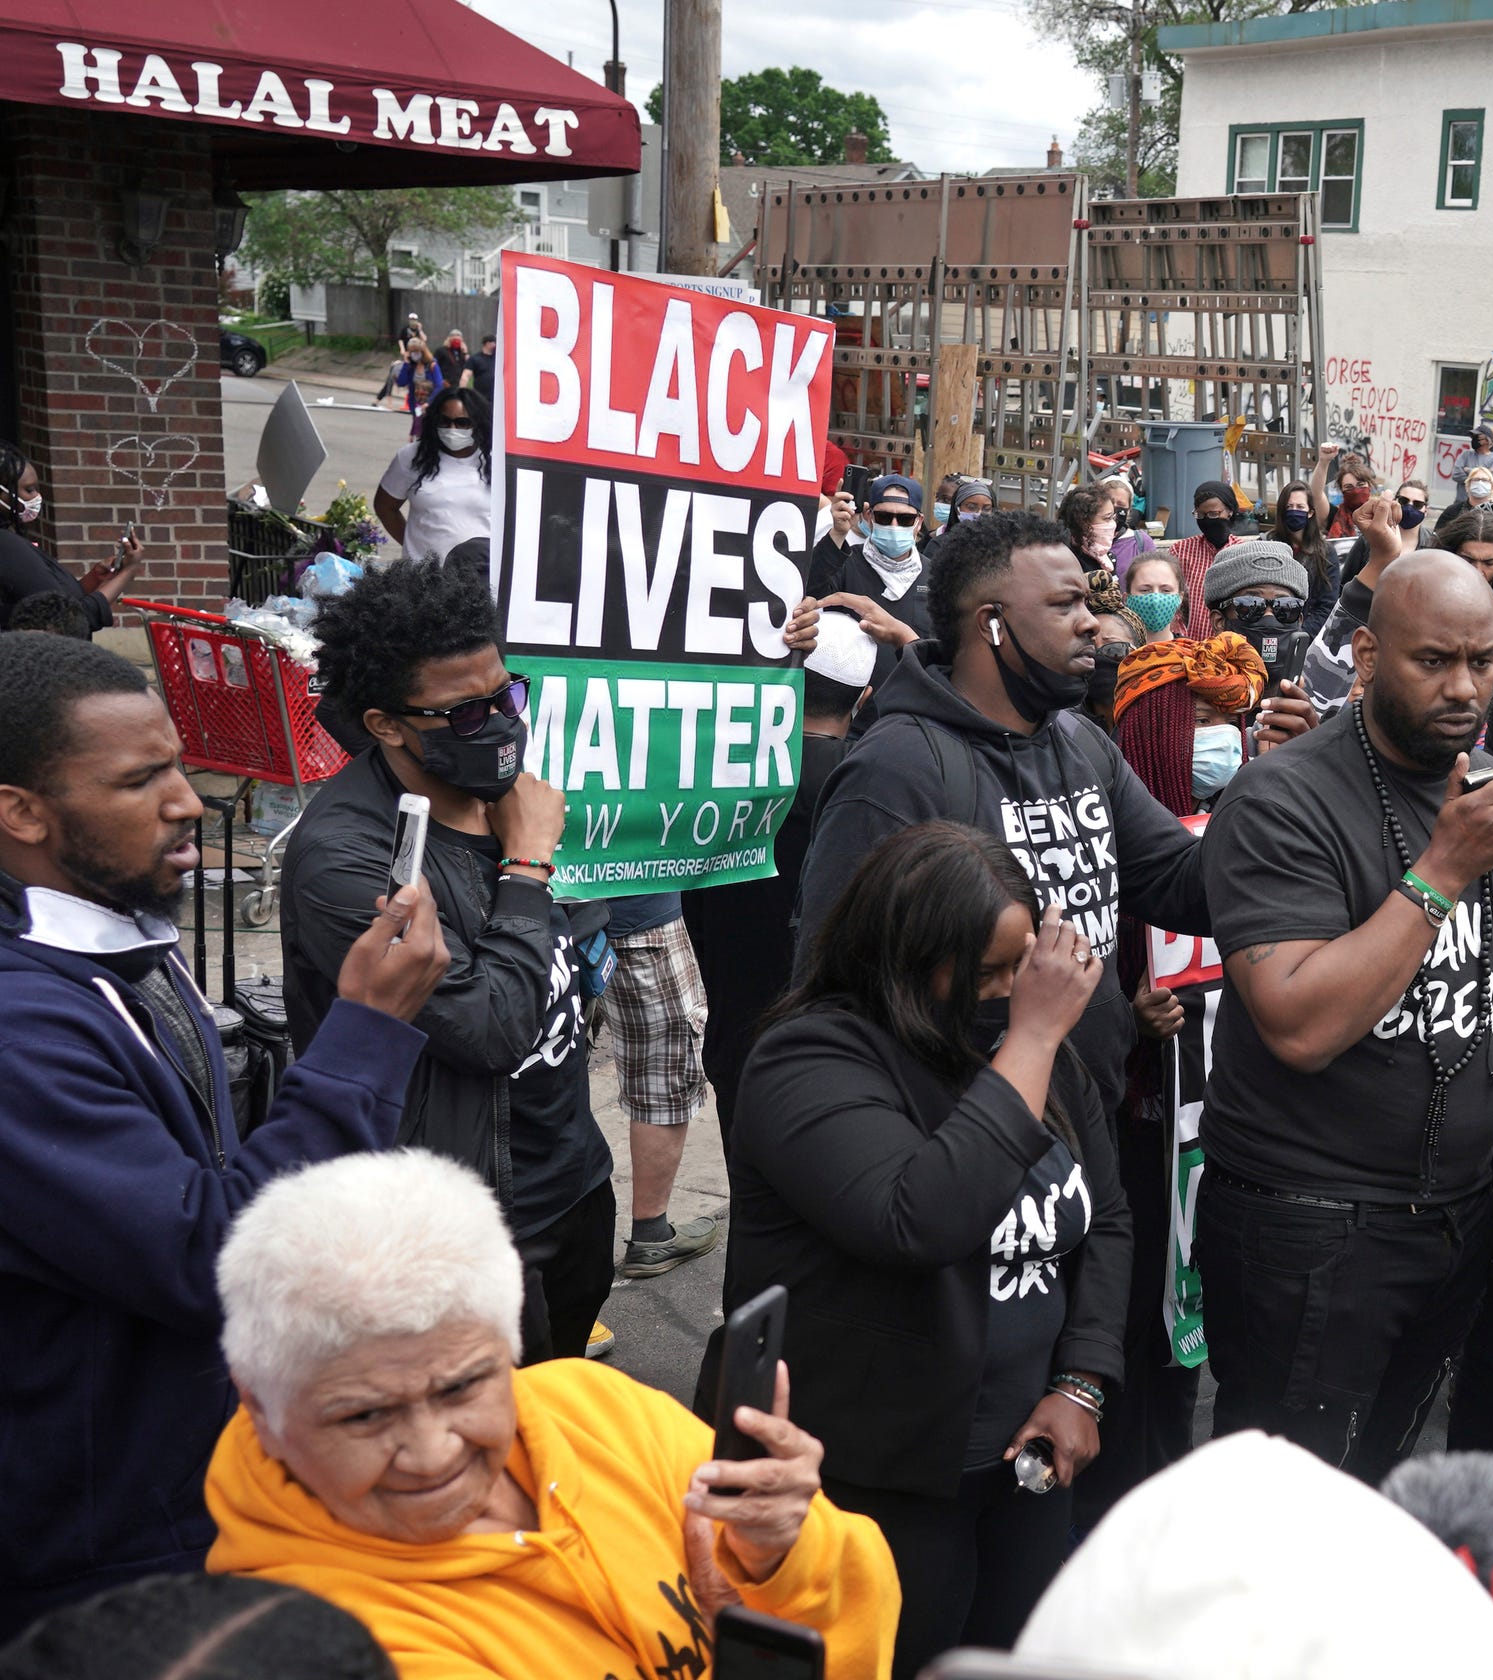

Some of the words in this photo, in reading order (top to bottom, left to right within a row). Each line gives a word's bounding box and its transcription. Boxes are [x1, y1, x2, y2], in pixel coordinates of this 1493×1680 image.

[56, 42, 351, 135] HALAL
[373, 87, 580, 157] MEAT
[705, 286, 743, 299] SIGNUP
[516, 265, 829, 483] BLACK
[1351, 387, 1399, 414] FLOYD
[1359, 413, 1427, 444] MATTERED
[505, 468, 806, 659] LIVES
[659, 797, 787, 848] YORK
[1000, 792, 1110, 844] BENG
[1049, 880, 1102, 909] NOT
